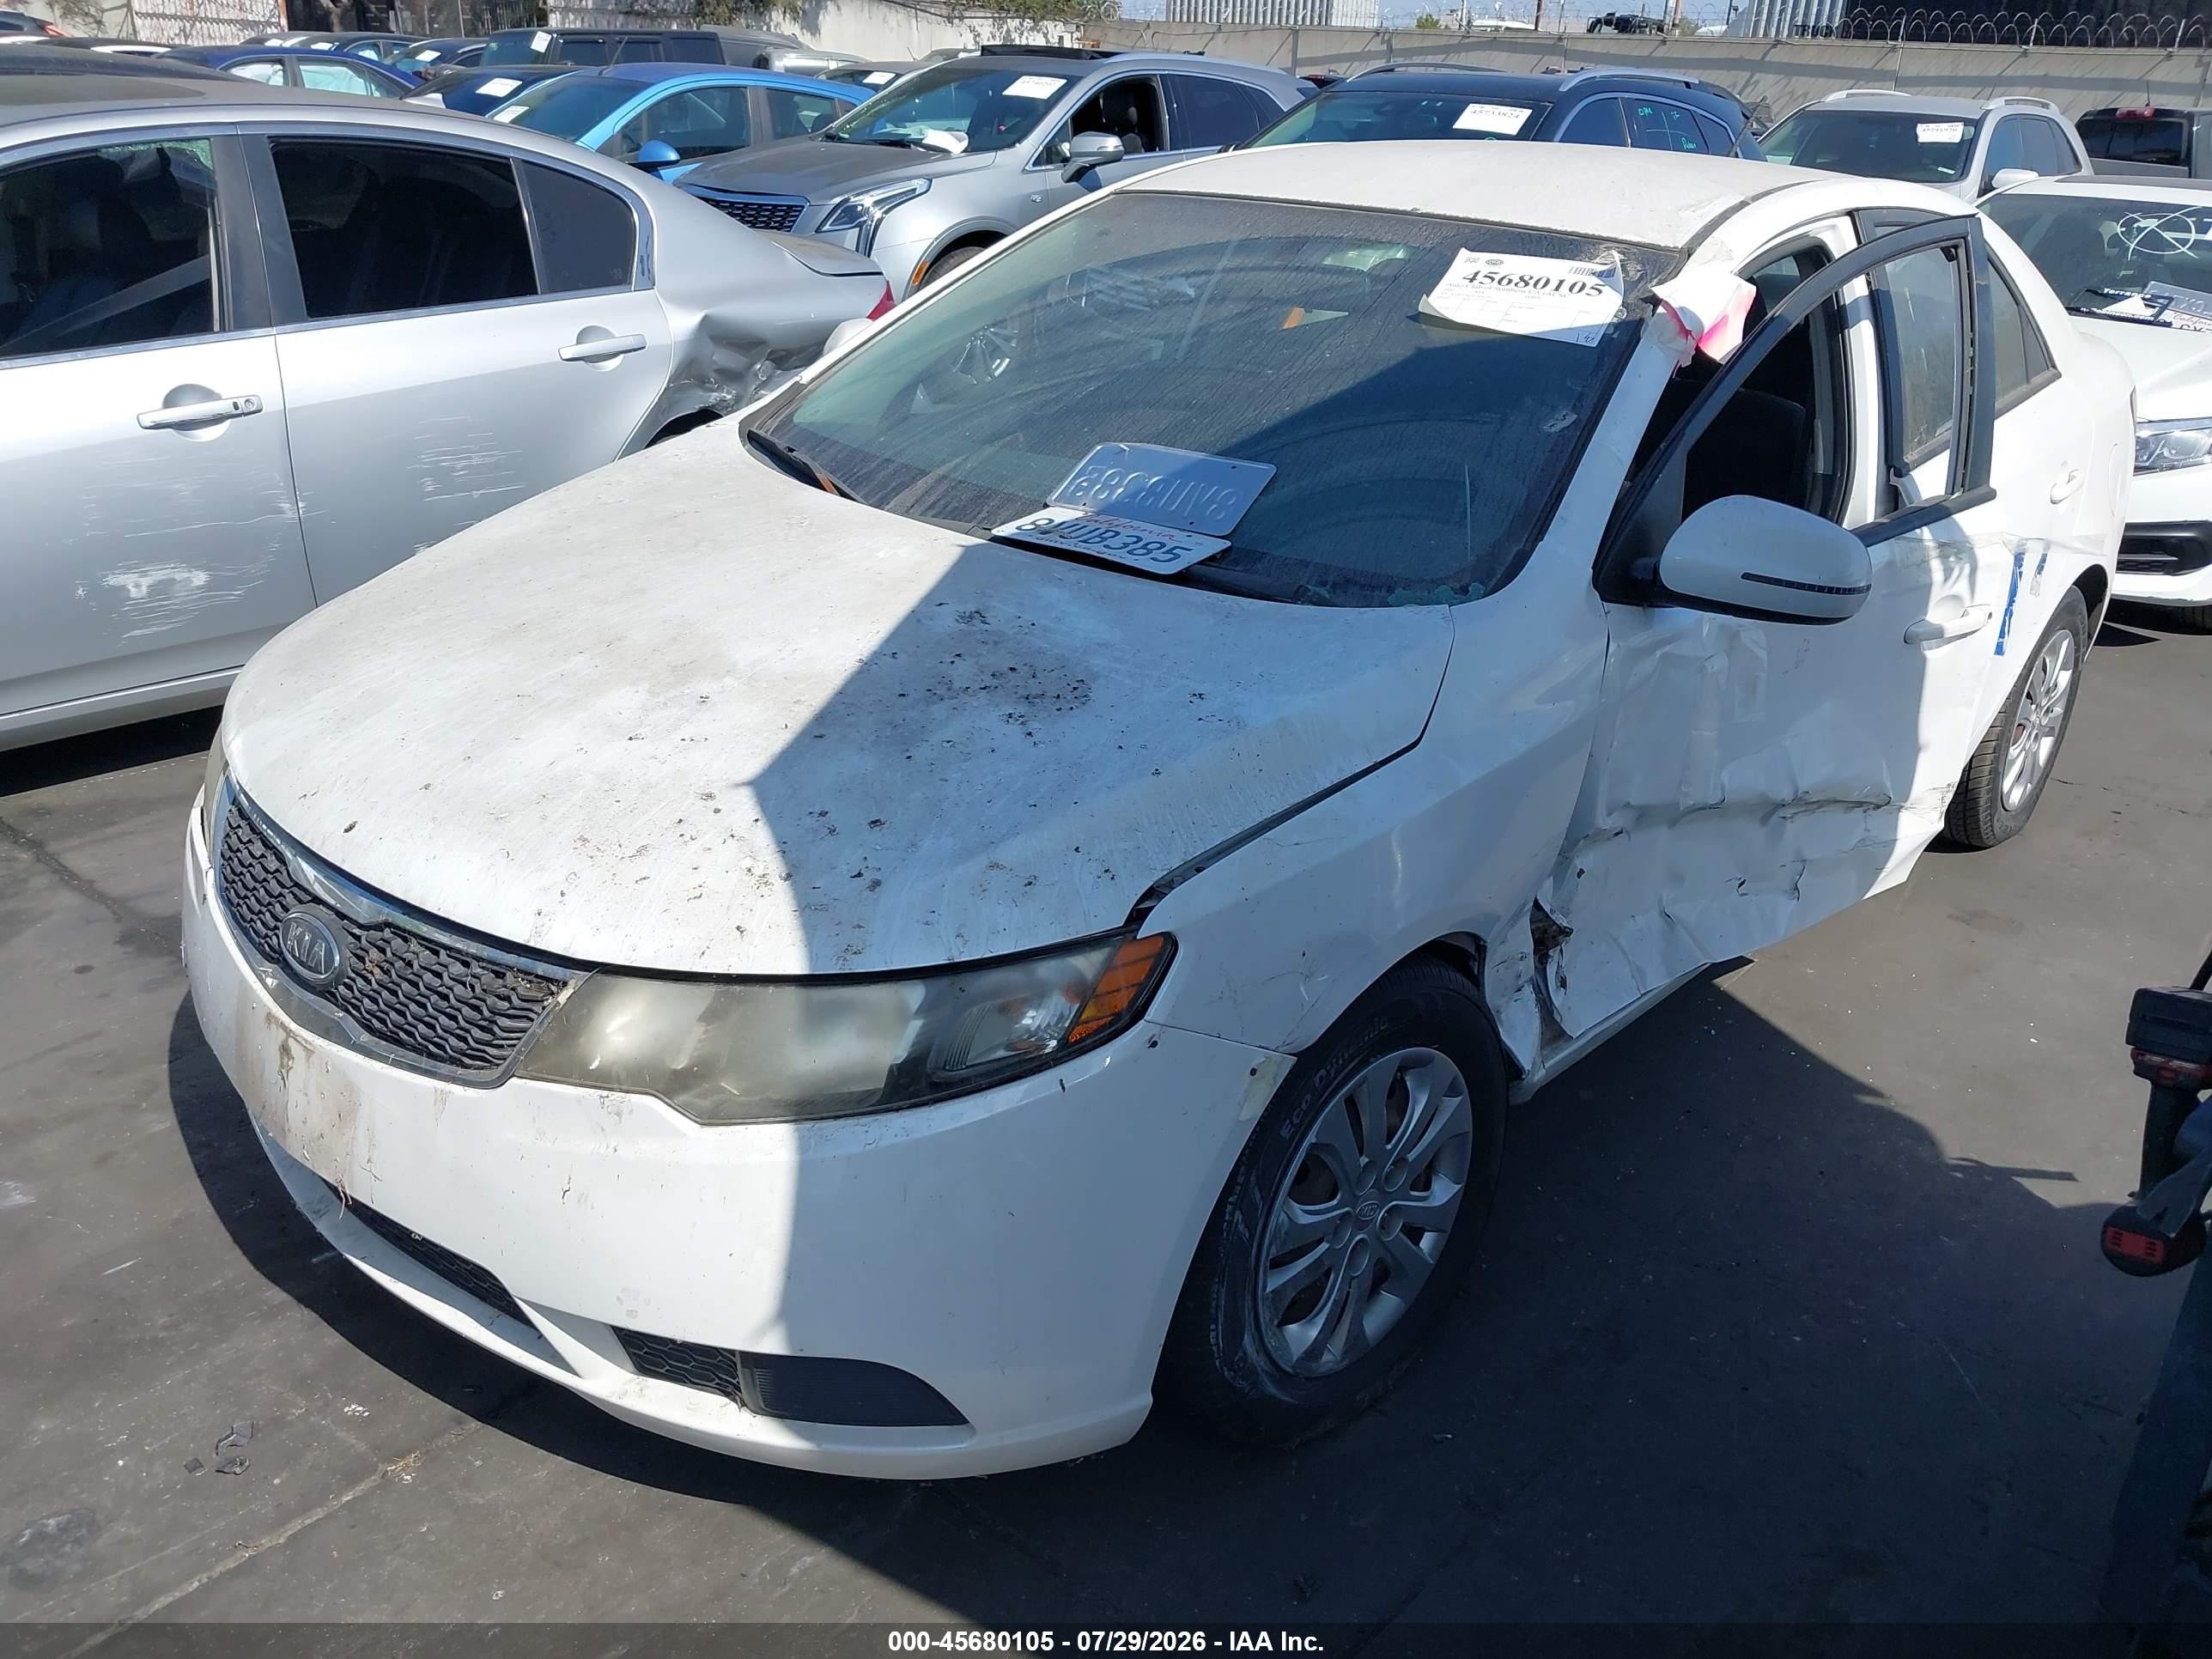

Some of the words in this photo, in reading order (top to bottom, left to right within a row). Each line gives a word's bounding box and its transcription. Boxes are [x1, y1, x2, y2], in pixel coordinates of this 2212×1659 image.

[1462, 269, 1607, 298] 45680105
[2102, 288, 2152, 299] Torrance
[1074, 514, 1183, 544] California
[286, 921, 325, 975] KIA
